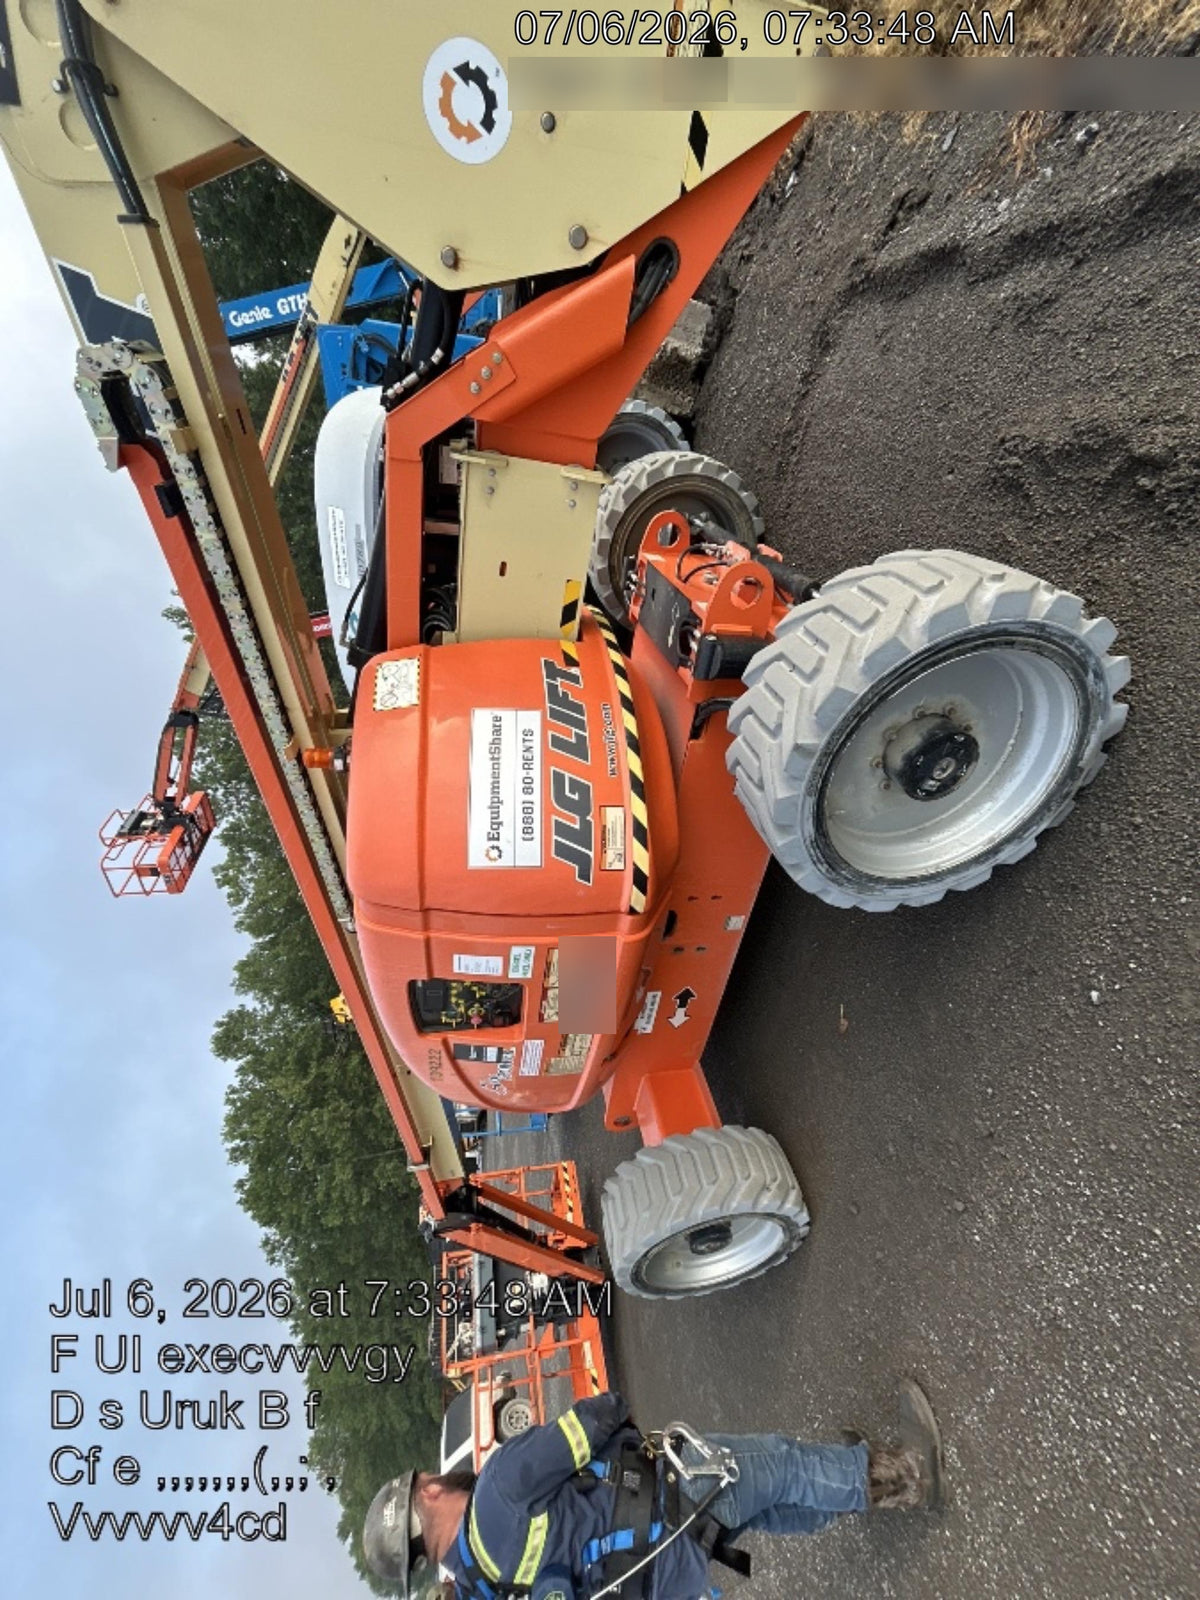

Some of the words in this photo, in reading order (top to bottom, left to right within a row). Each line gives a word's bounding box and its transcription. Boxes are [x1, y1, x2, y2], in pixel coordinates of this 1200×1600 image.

[228, 306, 274, 327] Genie
[541, 658, 591, 765] LIFT
[485, 713, 505, 843] EquipmentShare
[521, 727, 535, 796] 80-RENTS
[521, 799, 535, 842] (888)
[550, 768, 593, 886] JLG
